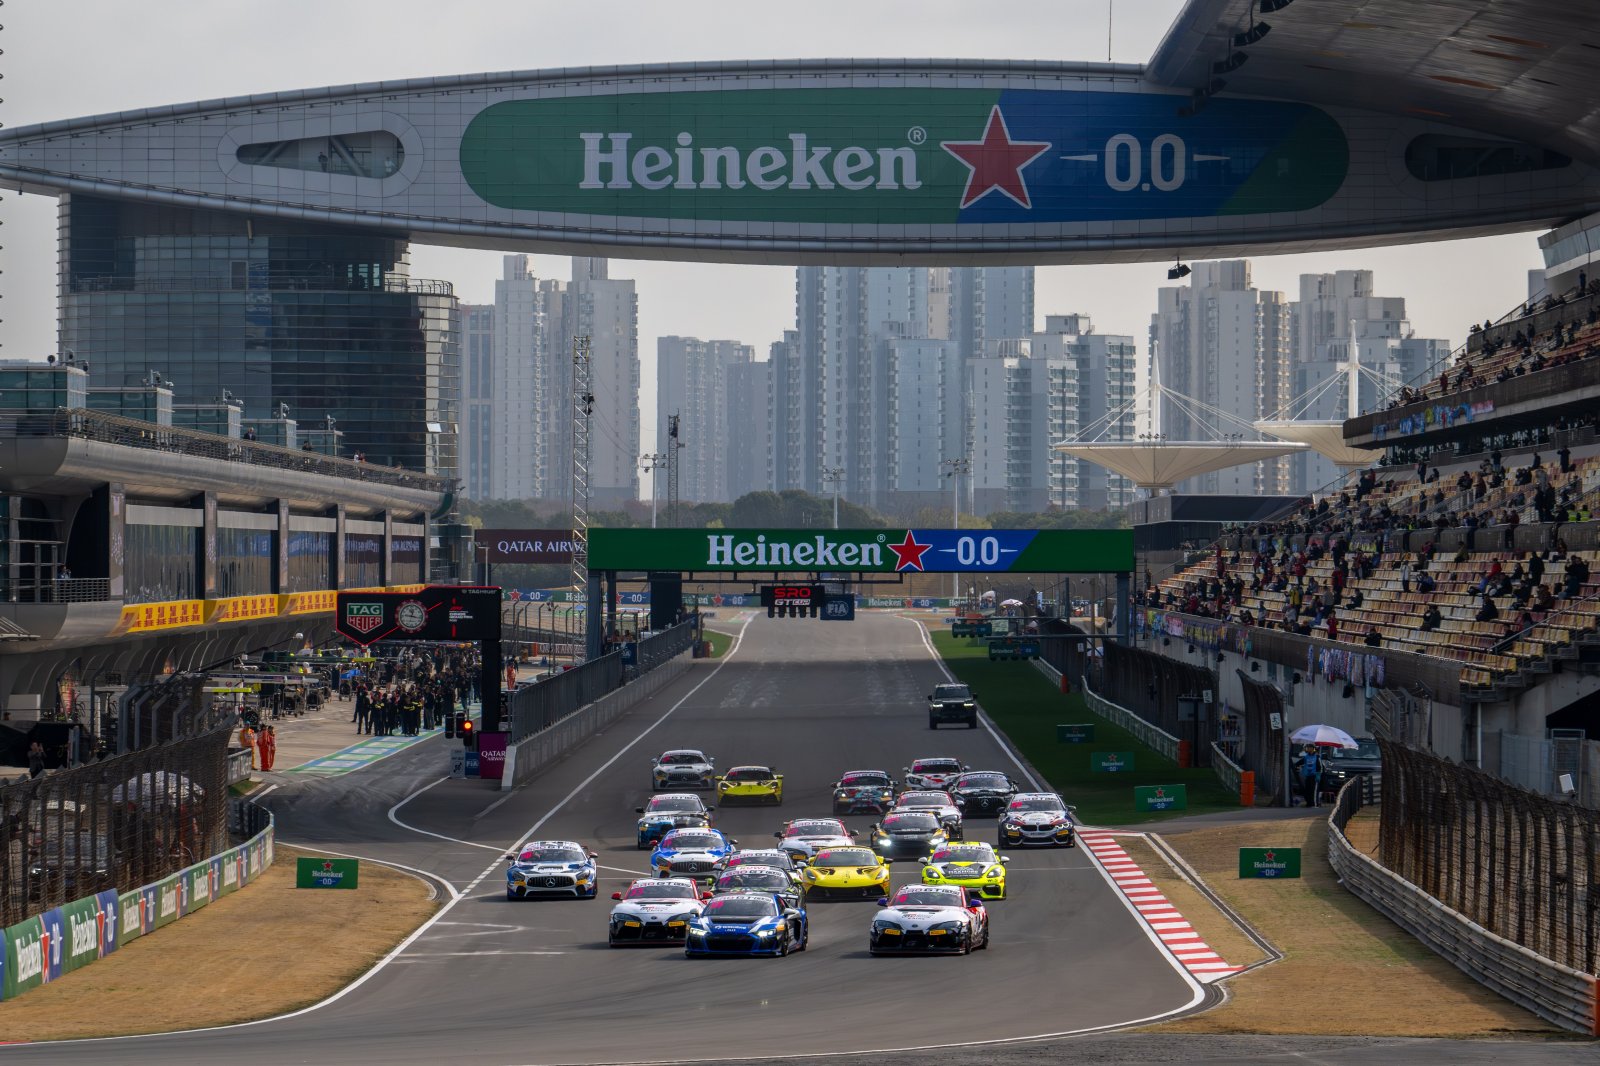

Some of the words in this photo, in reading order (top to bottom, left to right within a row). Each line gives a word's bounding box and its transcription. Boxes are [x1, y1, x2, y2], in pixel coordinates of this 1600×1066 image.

[579, 132, 922, 190] Heineken
[1105, 133, 1186, 192] 0.0
[498, 541, 543, 554] QATAR
[546, 541, 585, 553] AIRW
[707, 534, 883, 566] Heineken
[958, 536, 998, 566] 0.0
[774, 587, 811, 598] SRO
[350, 605, 381, 615] TAG
[350, 617, 381, 631] HEUER
[481, 750, 506, 758] QATAR
[1254, 861, 1286, 869] Heineken
[312, 870, 344, 878] Heineken
